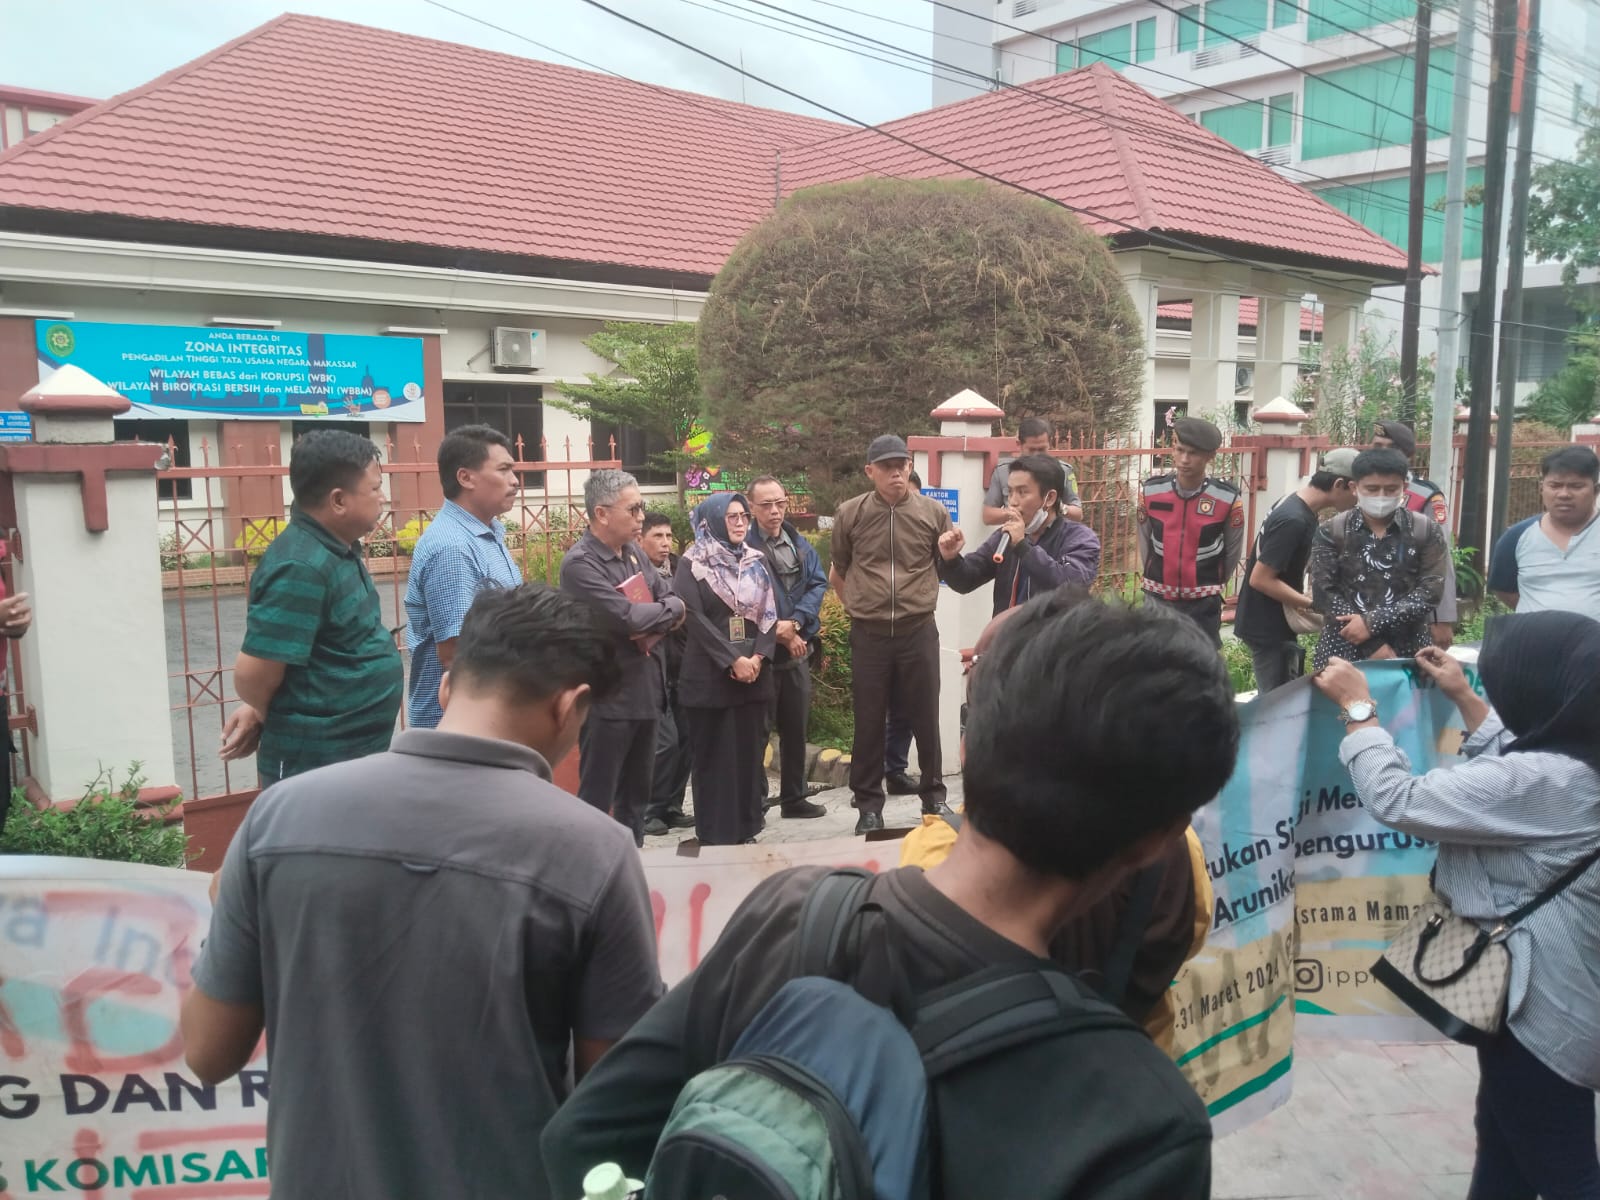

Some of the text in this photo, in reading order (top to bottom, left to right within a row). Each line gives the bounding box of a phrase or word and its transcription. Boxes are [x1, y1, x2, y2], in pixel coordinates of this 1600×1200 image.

[208, 332, 233, 340] ANDA
[236, 333, 269, 342] BERADA
[184, 341, 303, 356] ZONA INTEGRITAS
[121, 353, 184, 362] PENGADILAN
[186, 355, 219, 363] TINGGI
[221, 356, 242, 364] TATA
[276, 359, 311, 367] NEGARA
[313, 360, 357, 368] MAKASSAR
[149, 368, 337, 383] WILAYAH BEBAS dari KORUPSI (WBK)
[107, 381, 373, 397] WILAYAH BIROKRASI BERSIH dan MELAYANI (WBBM)
[925, 491, 949, 499] KANTOR
[1295, 831, 1434, 859] engurus
[1200, 979, 1242, 1018] Maret
[1293, 904, 1357, 925] srama
[59, 1072, 217, 1115] DAN
